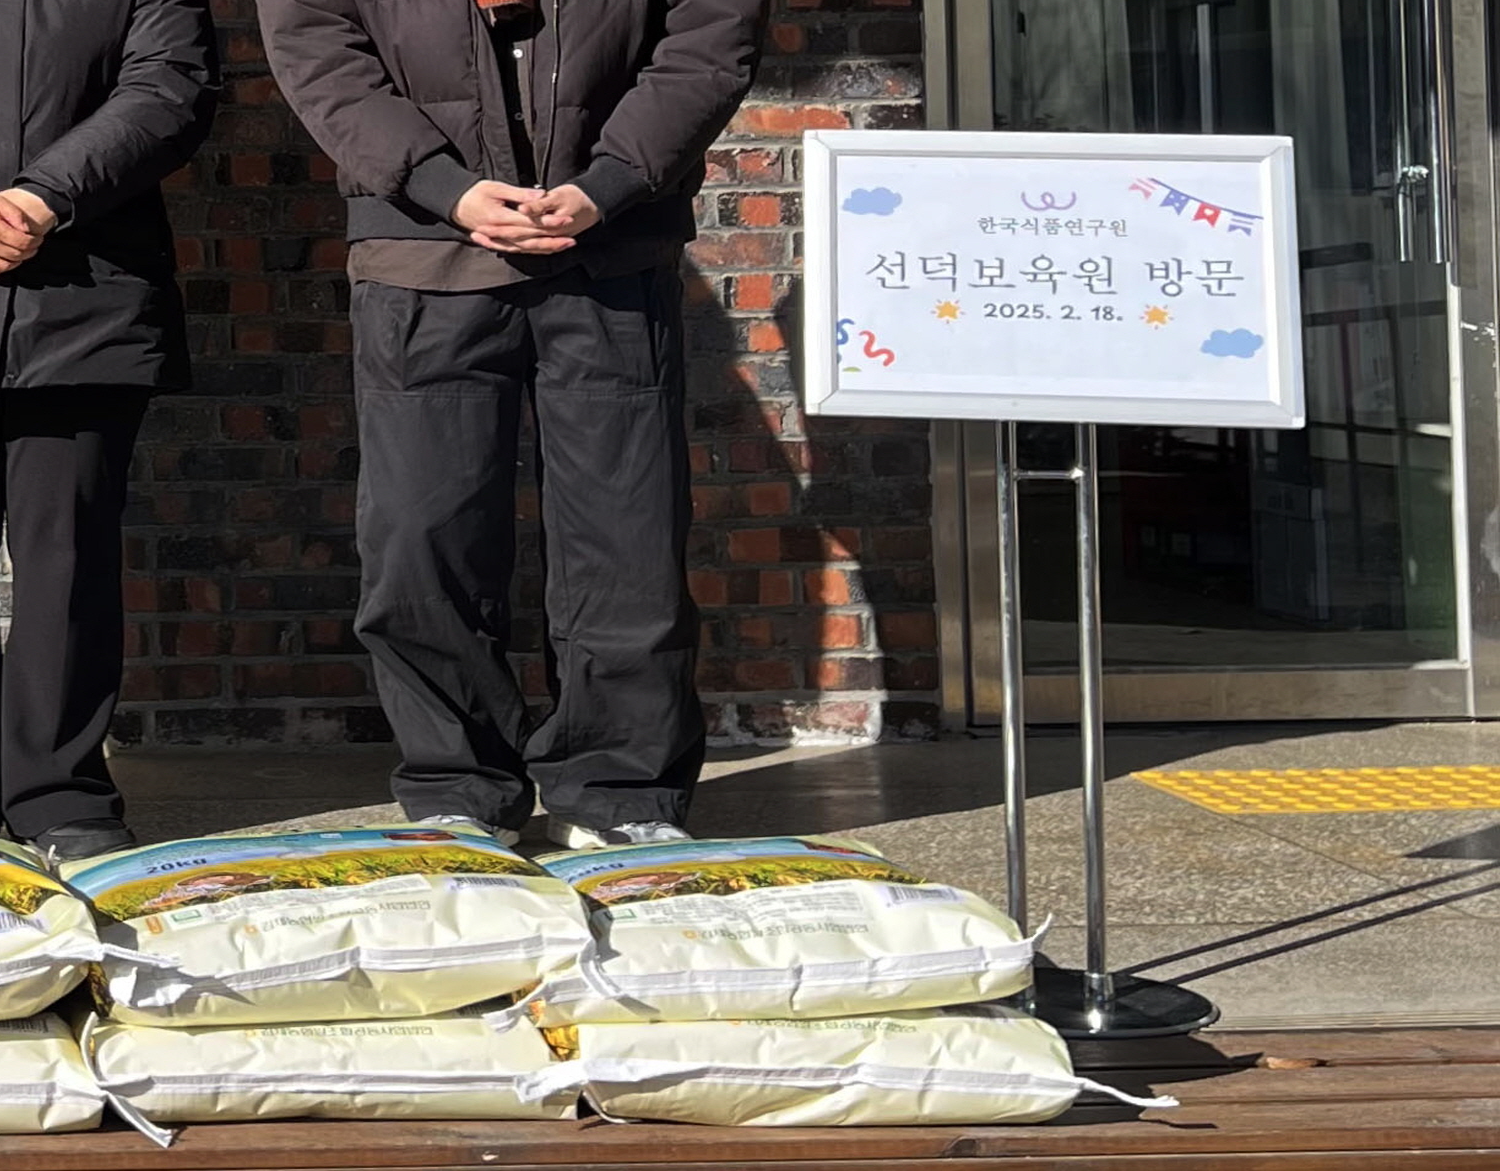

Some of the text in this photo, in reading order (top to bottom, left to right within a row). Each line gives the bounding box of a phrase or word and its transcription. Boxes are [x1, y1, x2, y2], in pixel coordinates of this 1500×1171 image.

[977, 216, 1129, 238] 한국식품연구원
[866, 250, 1245, 298] 선덕보육원 방문
[983, 302, 1124, 322] 2025. 2. 18.
